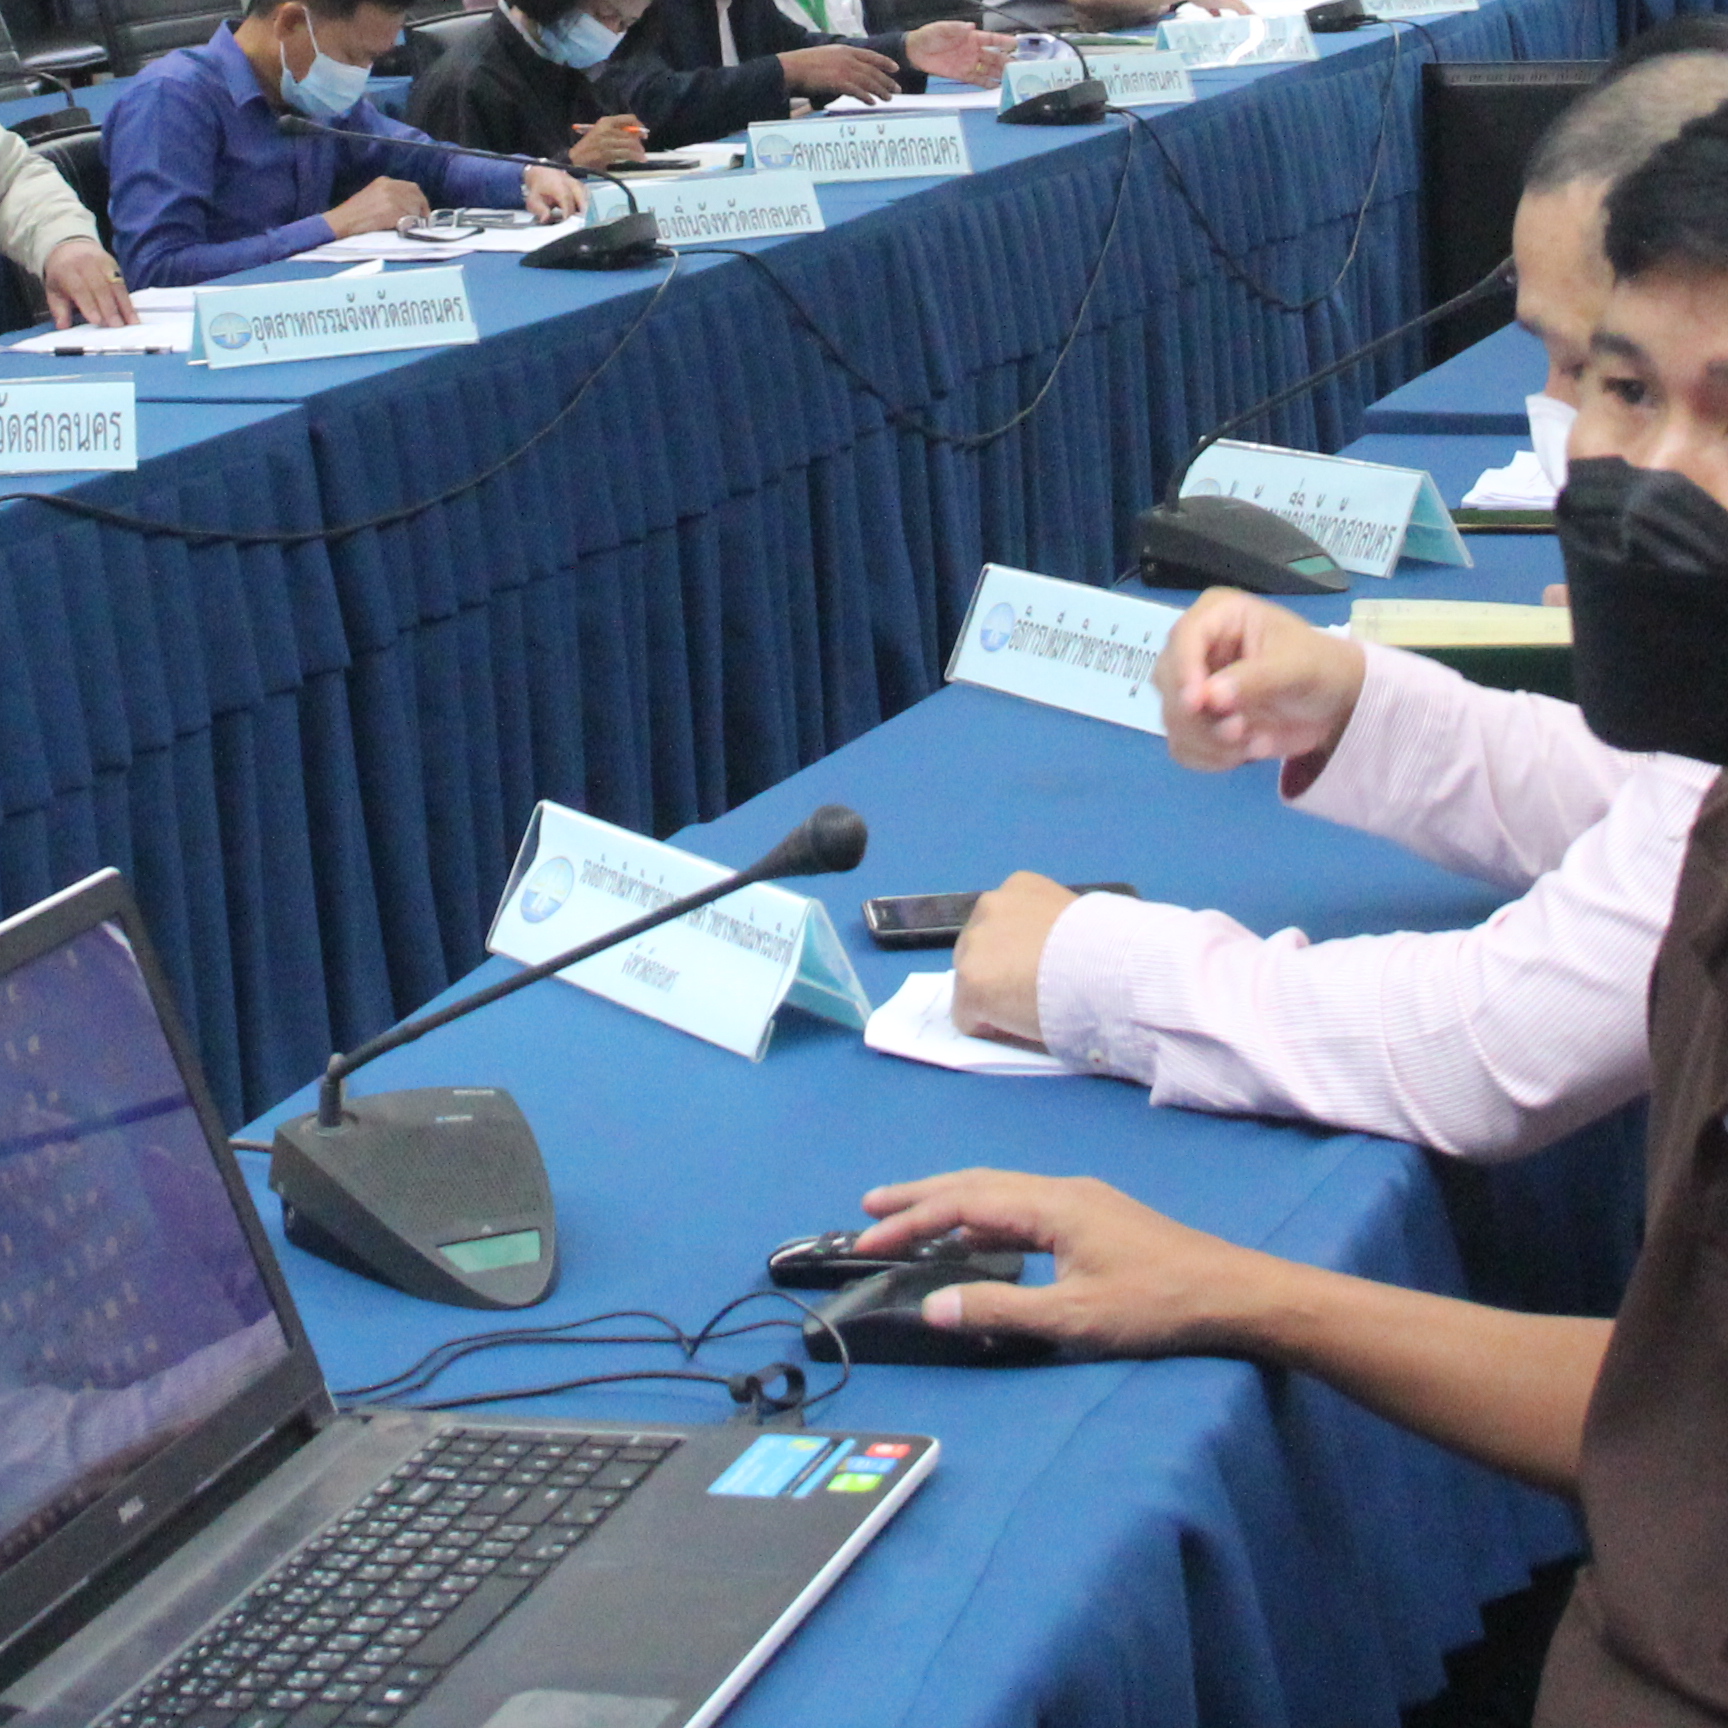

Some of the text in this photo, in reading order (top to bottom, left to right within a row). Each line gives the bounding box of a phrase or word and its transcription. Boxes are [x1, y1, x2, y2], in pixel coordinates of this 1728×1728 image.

[647, 196, 813, 239] ้องถิ่นจังหวัดสกลนคร
[251, 289, 465, 355] อุตสาหกรรมจังหวัดสกลนคร
